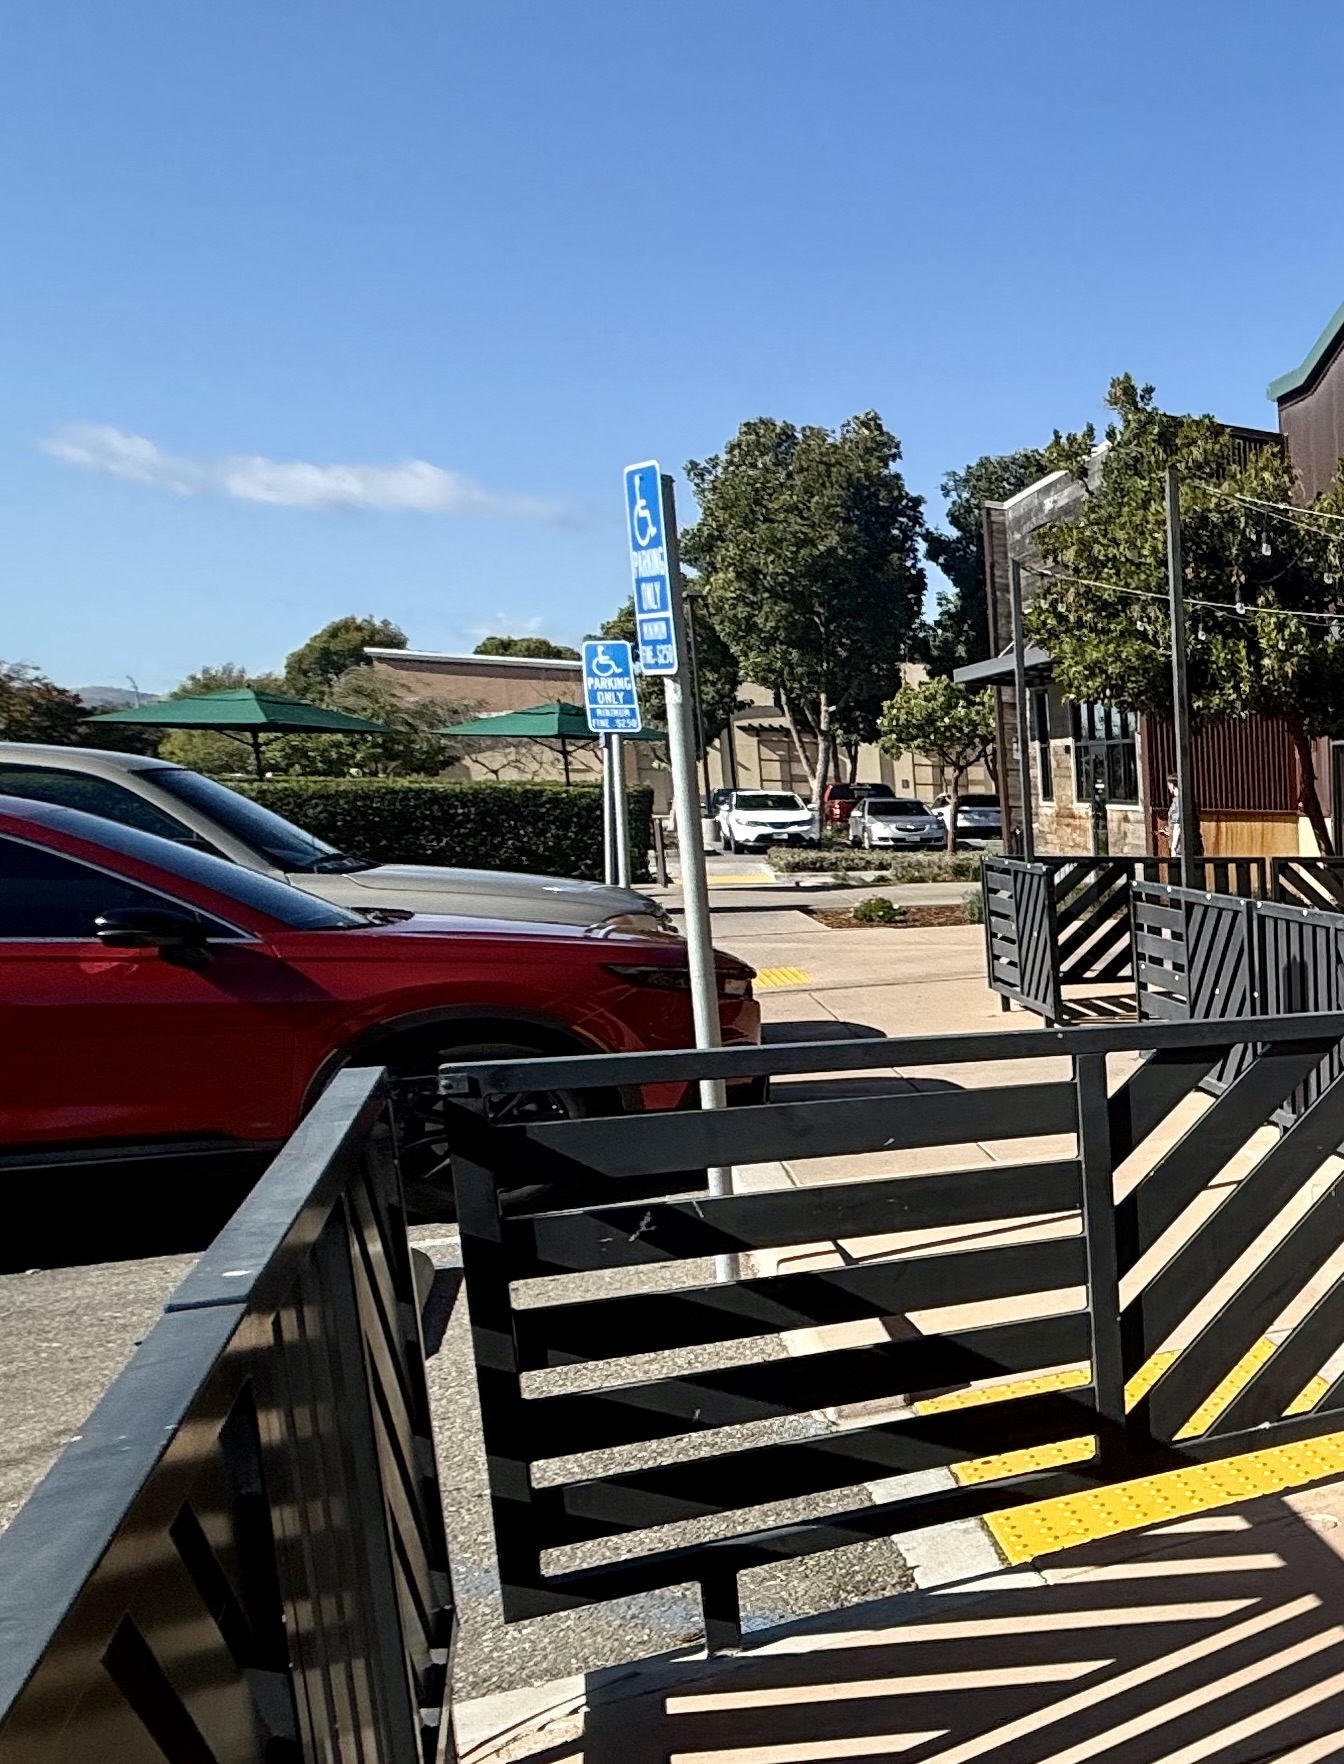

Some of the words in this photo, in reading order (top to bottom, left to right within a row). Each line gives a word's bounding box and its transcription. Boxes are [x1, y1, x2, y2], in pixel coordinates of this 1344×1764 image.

[640, 581, 661, 611] ONLY
[587, 677, 631, 690] PARKING
[597, 692, 625, 705] ONLY
